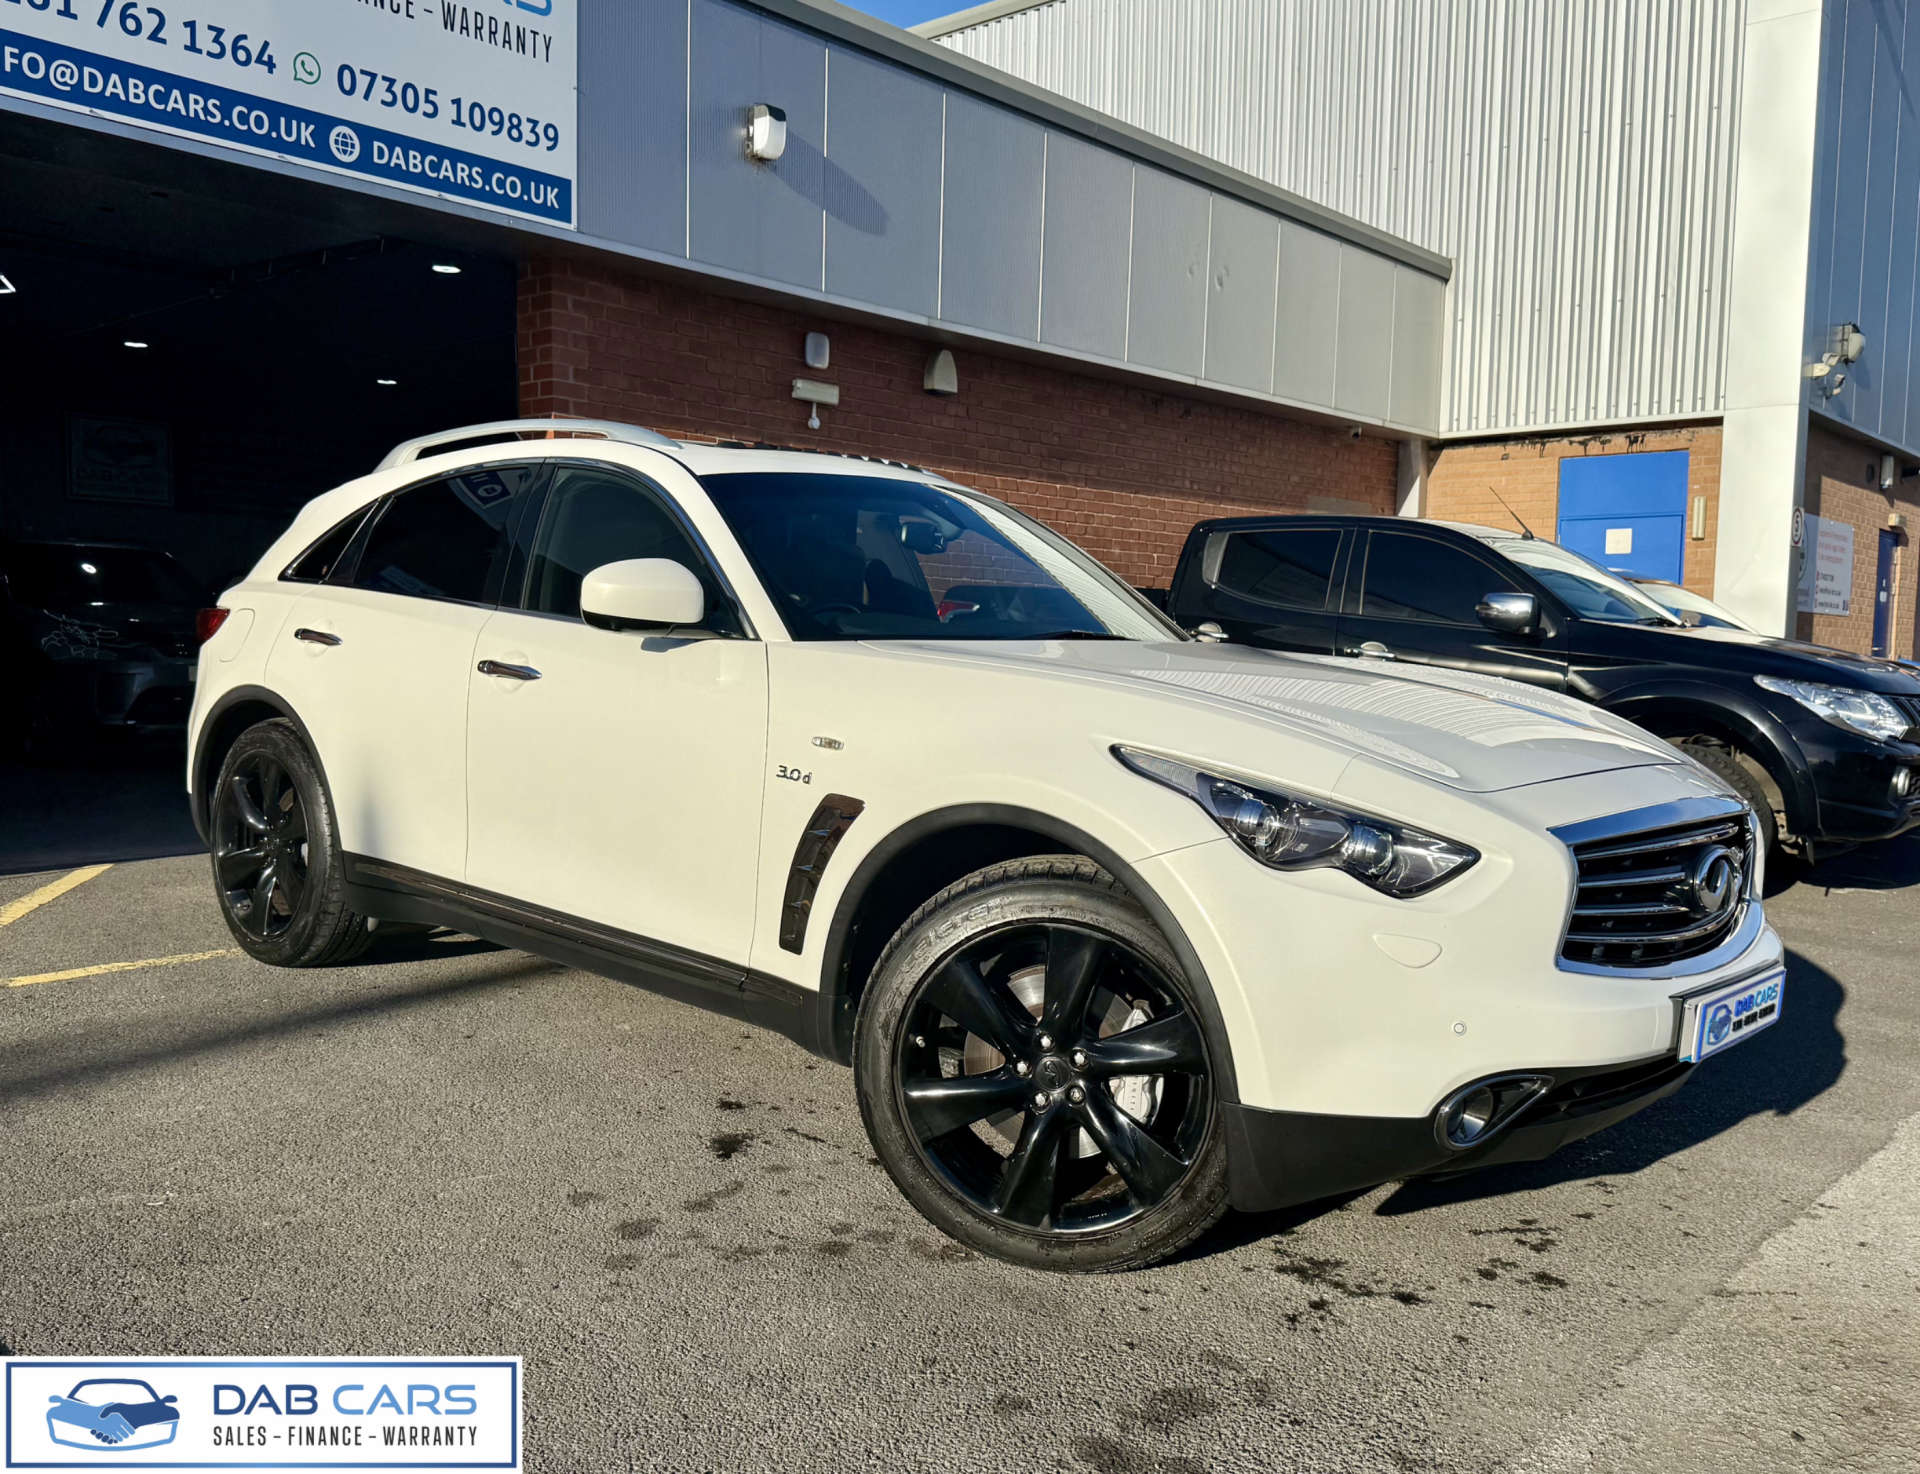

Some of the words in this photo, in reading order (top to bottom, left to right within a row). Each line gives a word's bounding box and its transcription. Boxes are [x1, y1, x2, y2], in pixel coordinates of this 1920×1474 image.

[97, 0, 167, 45] 762
[183, 19, 277, 75] 1364
[442, 0, 552, 63] WARRANTY
[337, 63, 439, 119] 07305
[450, 97, 560, 152] 109839
[372, 140, 560, 209] DABCARS.CO.UK
